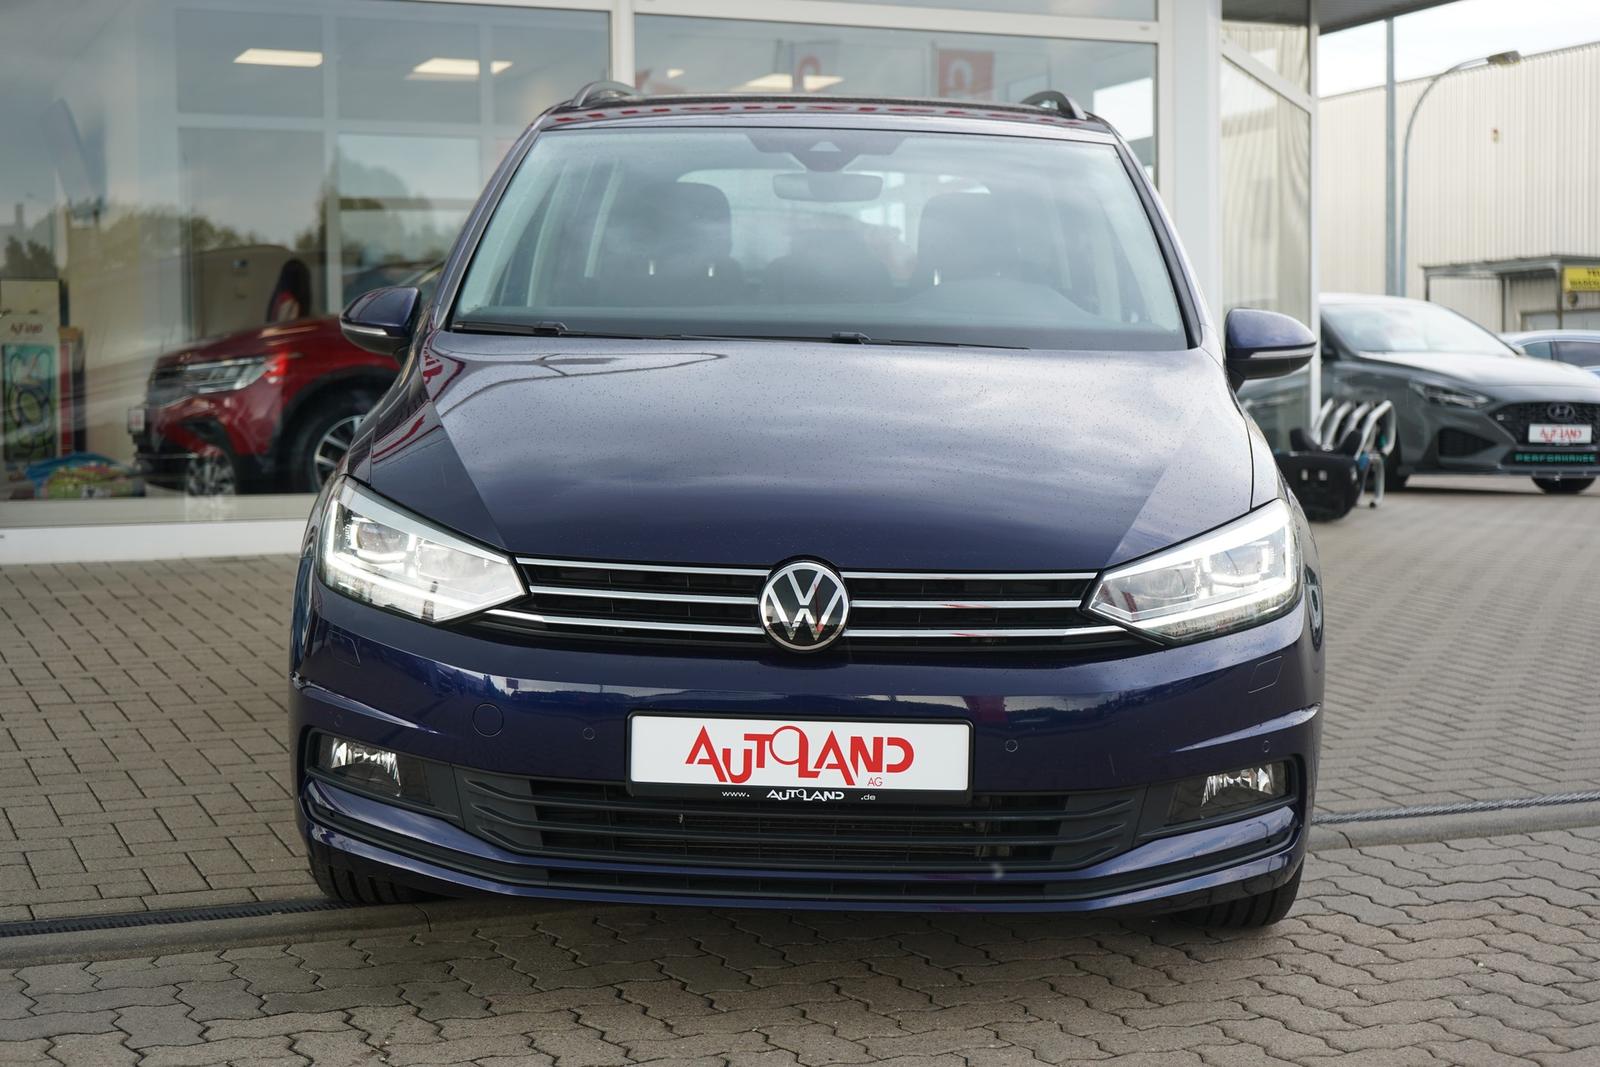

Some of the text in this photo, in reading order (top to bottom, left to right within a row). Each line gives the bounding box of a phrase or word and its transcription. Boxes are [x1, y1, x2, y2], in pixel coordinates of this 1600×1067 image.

[1515, 453, 1595, 462] PERFORMANCE
[685, 725, 914, 786] AUTOLAND
[867, 776, 883, 787] AG
[767, 788, 844, 801] AUTOLAND
